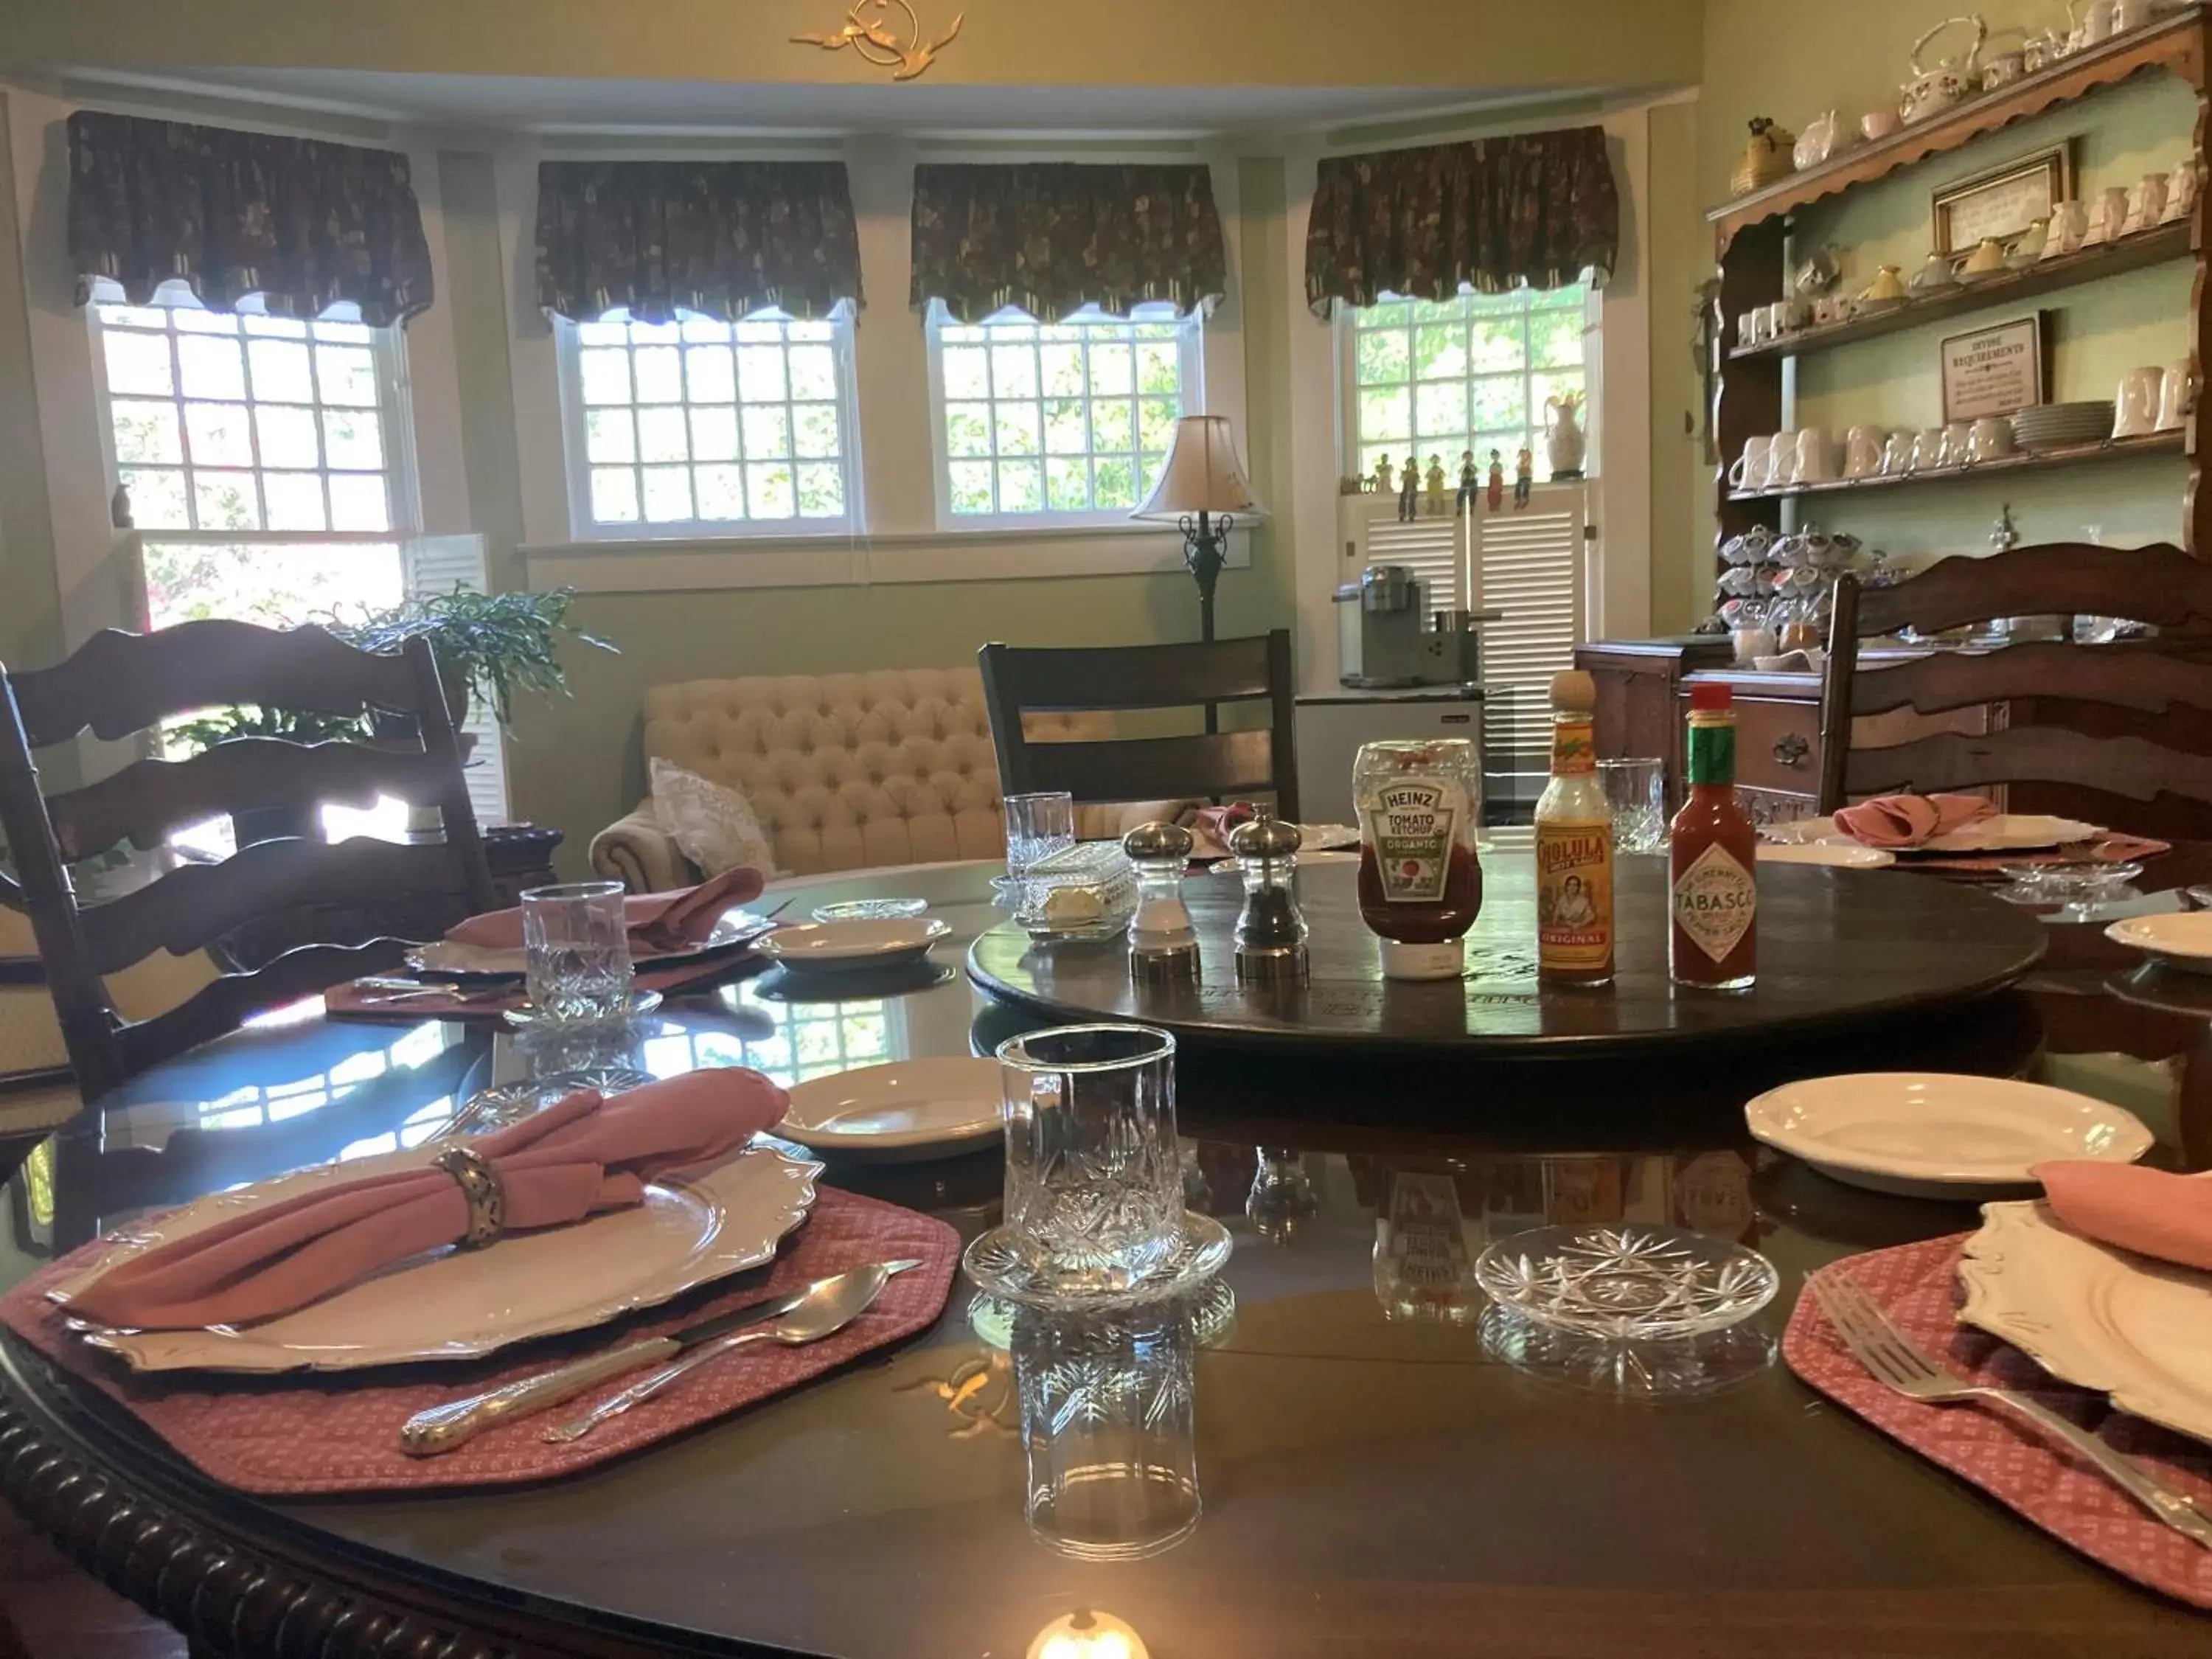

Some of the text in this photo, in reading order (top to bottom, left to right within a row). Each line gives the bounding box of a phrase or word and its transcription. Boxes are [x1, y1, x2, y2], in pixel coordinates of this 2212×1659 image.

[1972, 336, 2002, 352] DIVINE
[1952, 343, 2025, 368] REQUIREMENTS
[1387, 791, 1433, 807] HEINZ
[1388, 814, 1434, 827] TOMATO
[1391, 825, 1433, 835] KETCHUP
[1387, 840, 1437, 850] ORGANIC
[1537, 837, 1604, 869] CHOLULA
[1541, 933, 1603, 945] ORIGINAL
